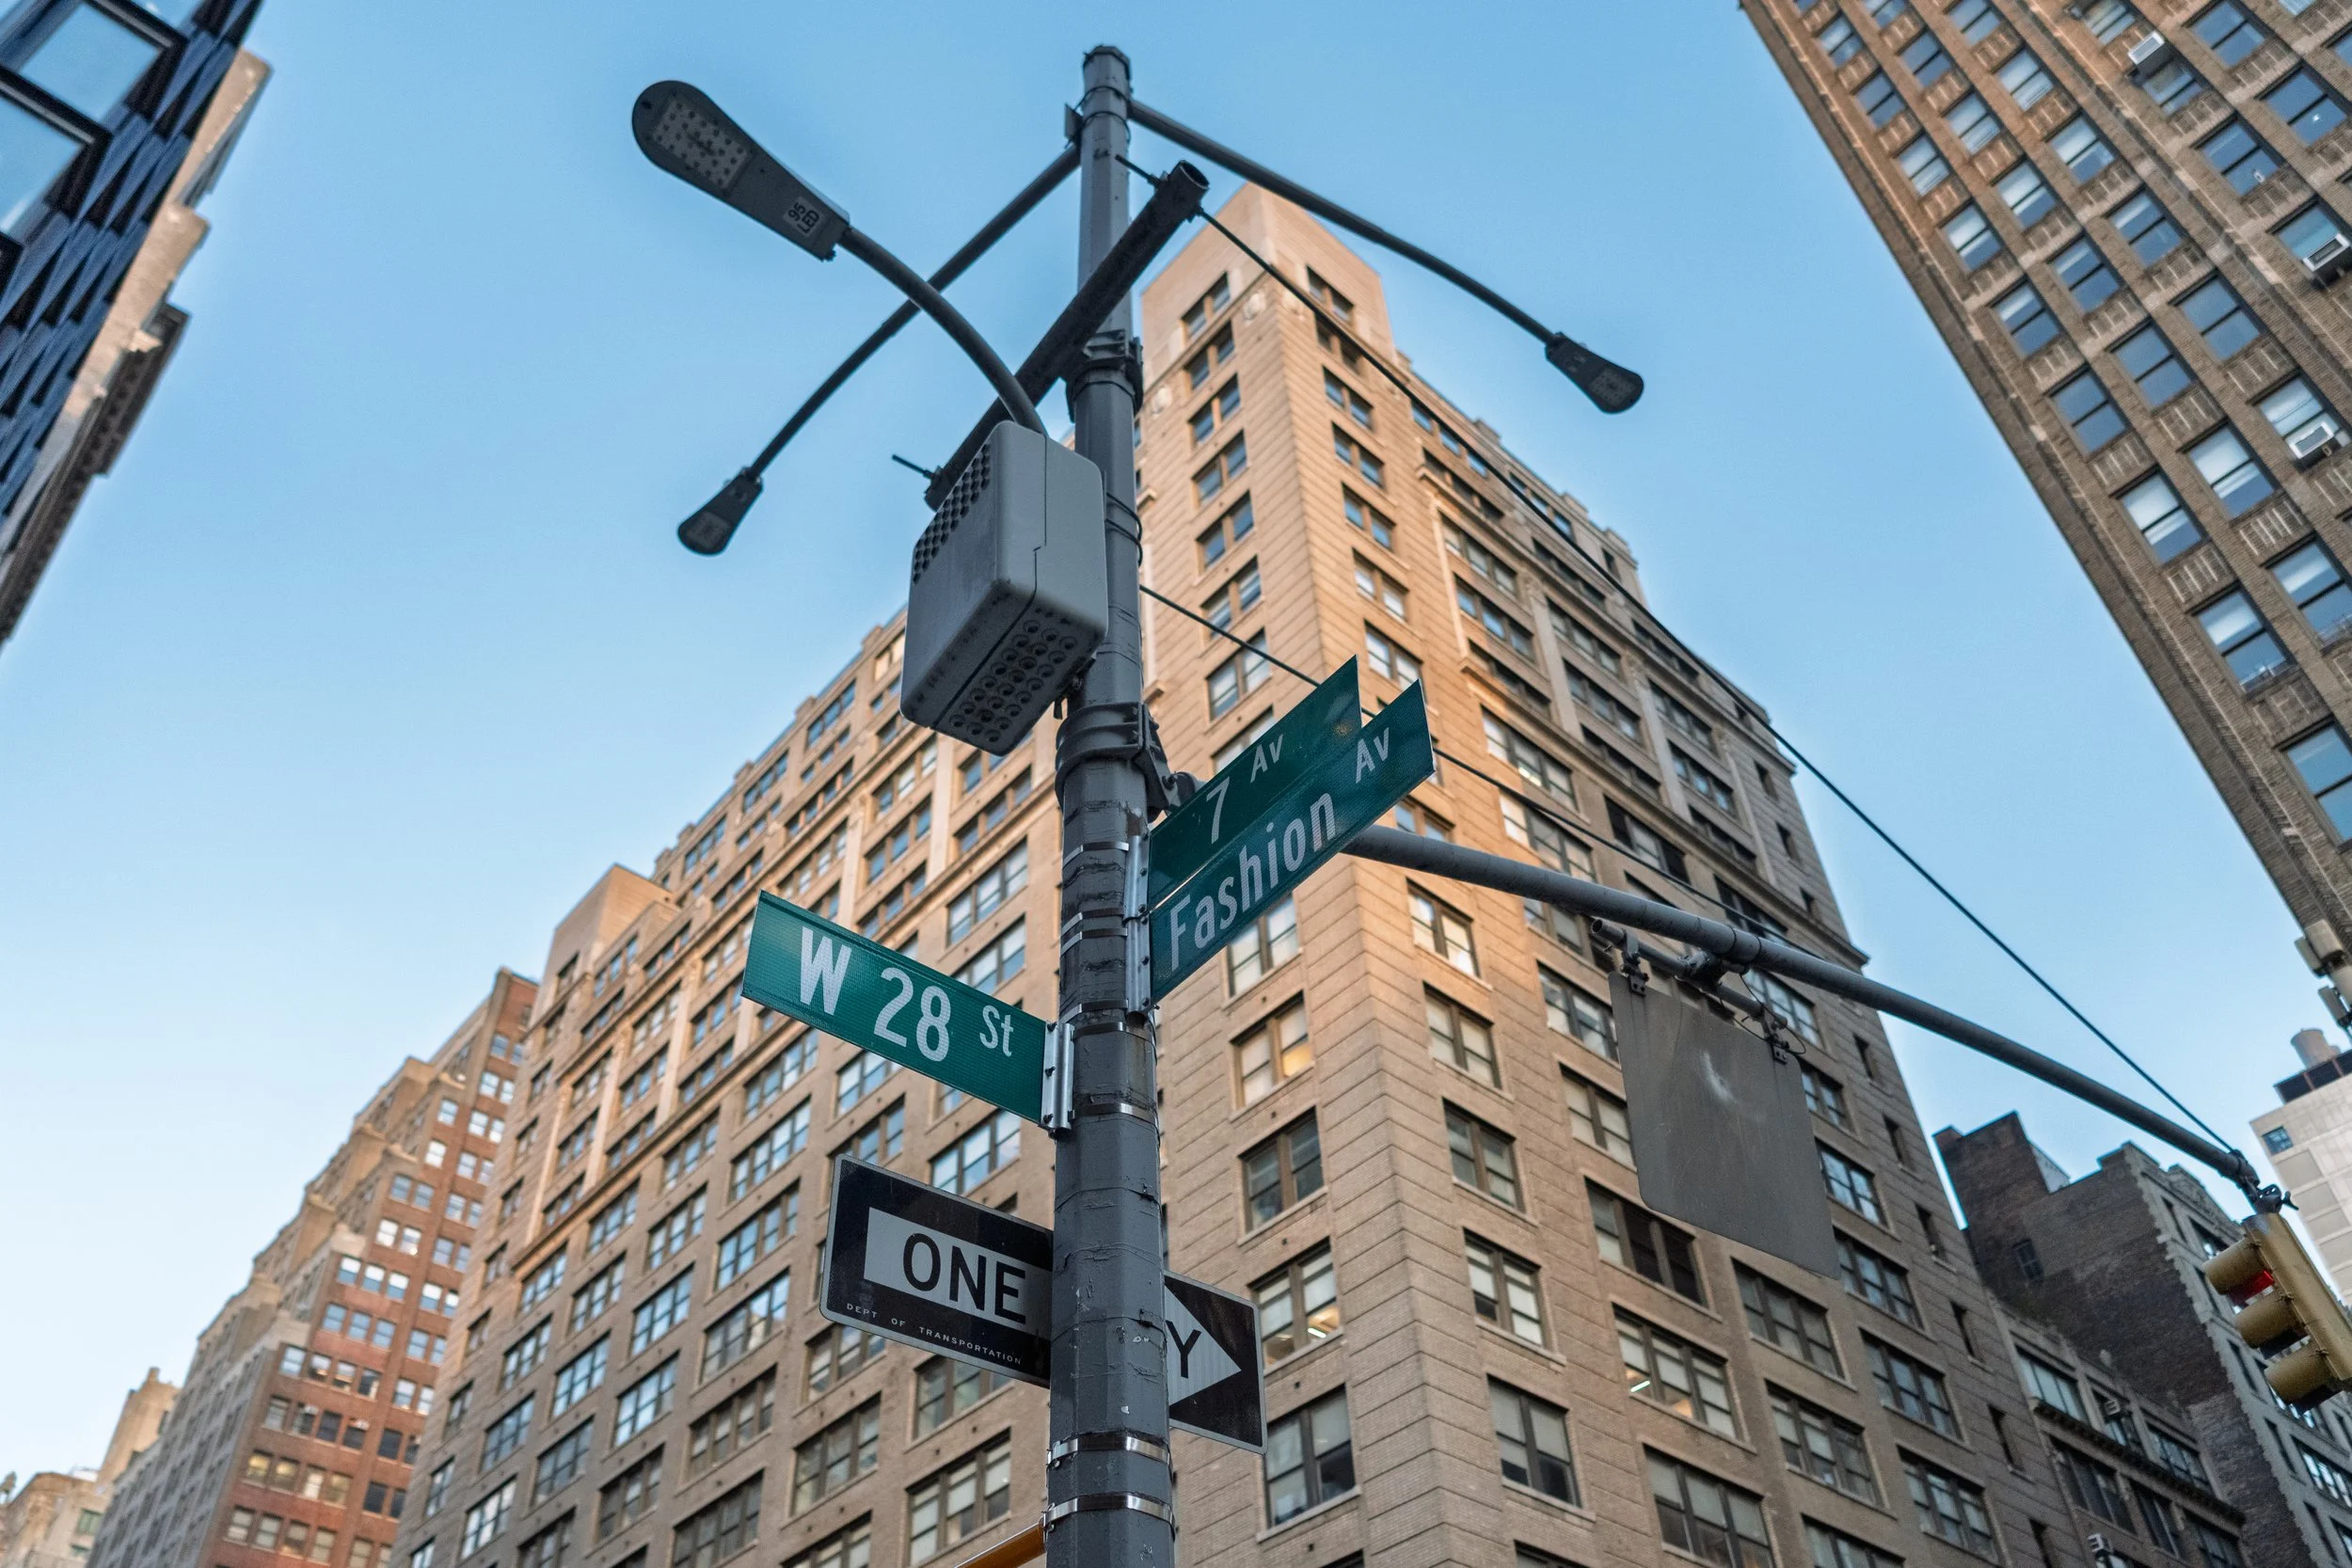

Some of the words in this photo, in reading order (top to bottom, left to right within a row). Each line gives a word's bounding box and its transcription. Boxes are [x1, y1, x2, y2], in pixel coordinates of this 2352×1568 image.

[797, 210, 819, 233] LED
[1205, 776, 1231, 845] 7
[1249, 734, 1284, 784] Av
[1169, 792, 1336, 972] Fashion
[1355, 727, 1390, 784] Av
[800, 926, 852, 1016] W
[873, 967, 952, 1062] 28
[979, 1005, 1014, 1057] St
[902, 1232, 1026, 1324] ONE
[846, 1303, 879, 1319] DEPT
[891, 1317, 906, 1328] OF
[918, 1326, 1023, 1365] TRANSPORTATION
